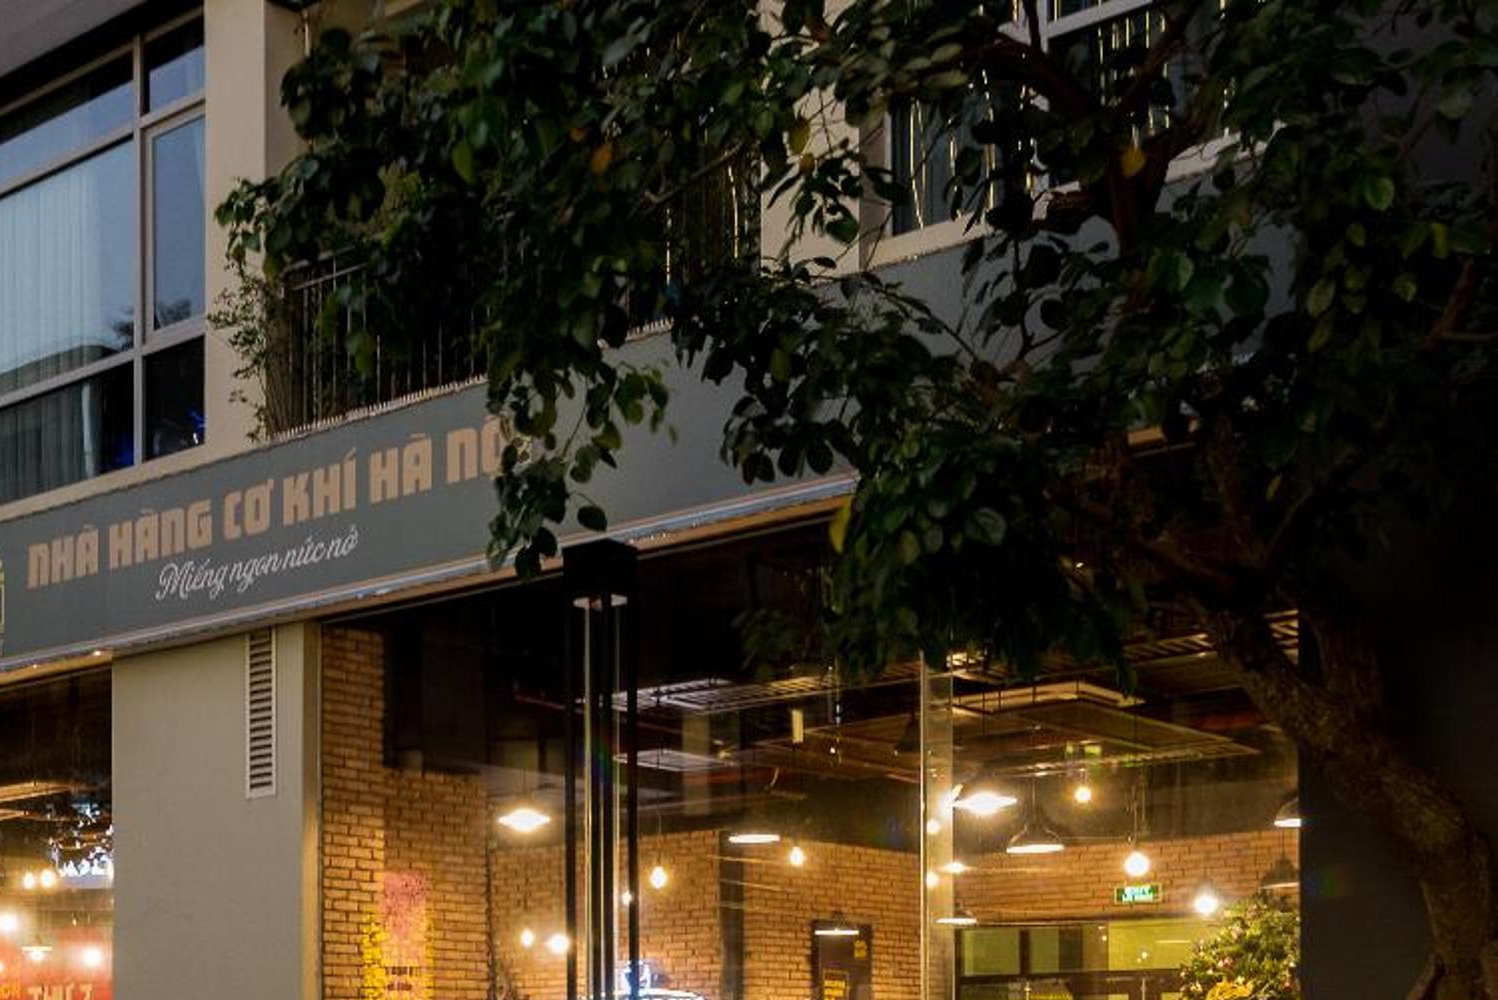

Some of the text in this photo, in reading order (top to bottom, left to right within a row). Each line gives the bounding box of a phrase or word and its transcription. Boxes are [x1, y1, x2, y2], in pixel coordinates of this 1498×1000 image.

[27, 524, 99, 589] NHÀ
[109, 500, 213, 569] HÀNG
[223, 479, 274, 540] CƠ
[283, 448, 356, 526] KHÍ
[369, 432, 432, 503] HÀ
[156, 524, 359, 600] Miếng ngon nức nở
